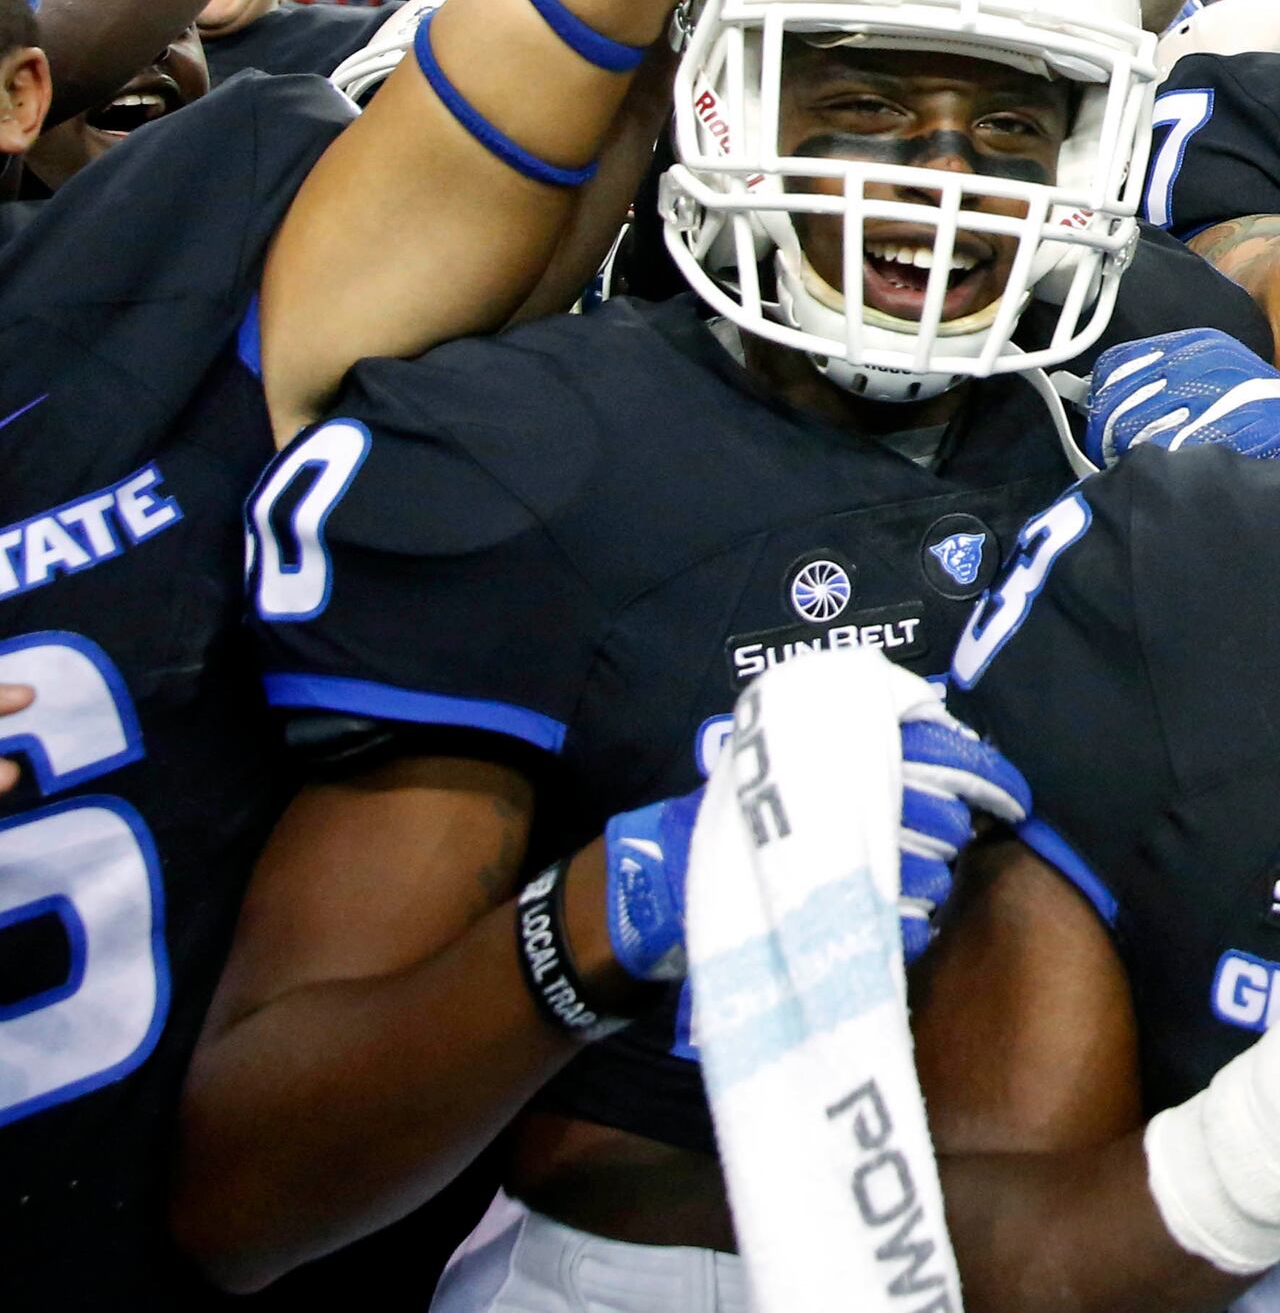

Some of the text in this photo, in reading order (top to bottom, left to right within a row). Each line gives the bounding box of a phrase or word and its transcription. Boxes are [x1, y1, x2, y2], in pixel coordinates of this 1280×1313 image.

[0, 460, 185, 599] TATE
[245, 417, 373, 623] 0
[829, 616, 923, 661] BELT
[521, 900, 560, 984] LOCAL
